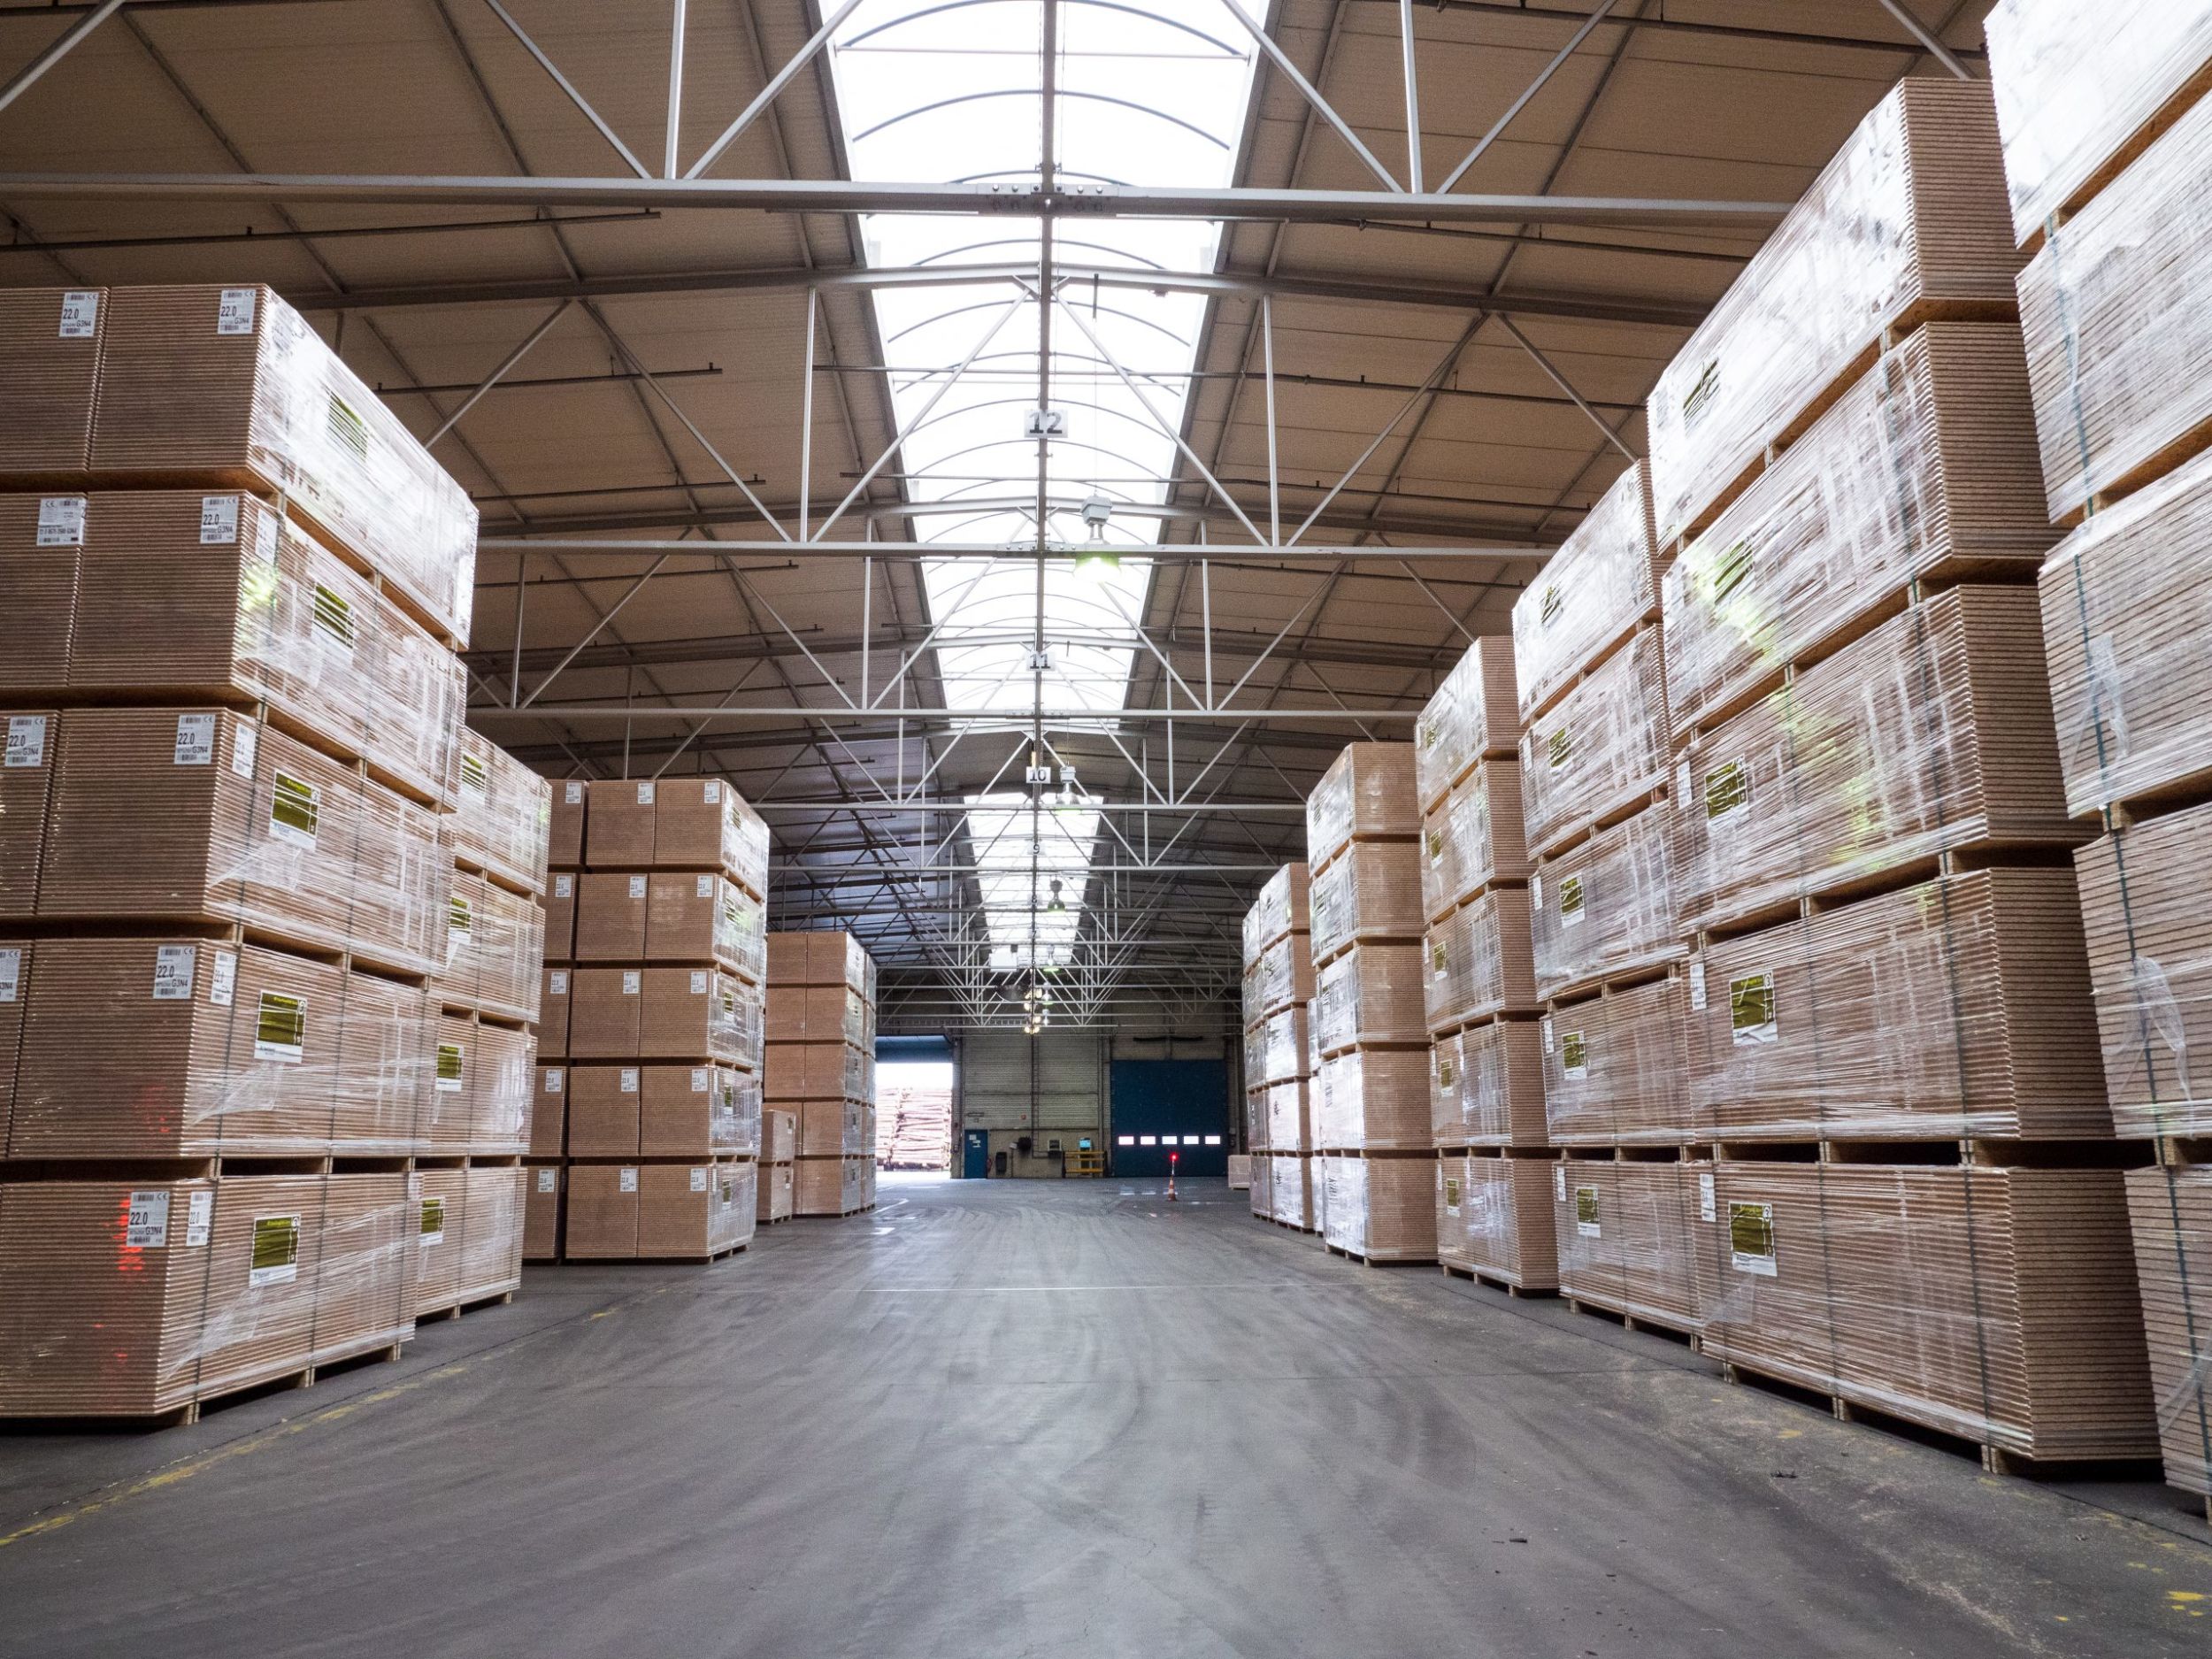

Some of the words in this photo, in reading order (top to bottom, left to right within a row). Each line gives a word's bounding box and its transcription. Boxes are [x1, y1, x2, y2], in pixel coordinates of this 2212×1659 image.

[63, 308, 79, 319] 22.0
[220, 306, 237, 317] 22.0
[1029, 411, 1062, 434] 12
[203, 514, 219, 525] 22.0
[1030, 654, 1050, 669] 11
[8, 735, 26, 747] 22.0
[177, 733, 195, 745] 22.0
[1029, 769, 1047, 781] 10
[1033, 843, 1040, 854] 9
[157, 965, 174, 978] 22.0
[130, 1212, 148, 1225] 22.0
